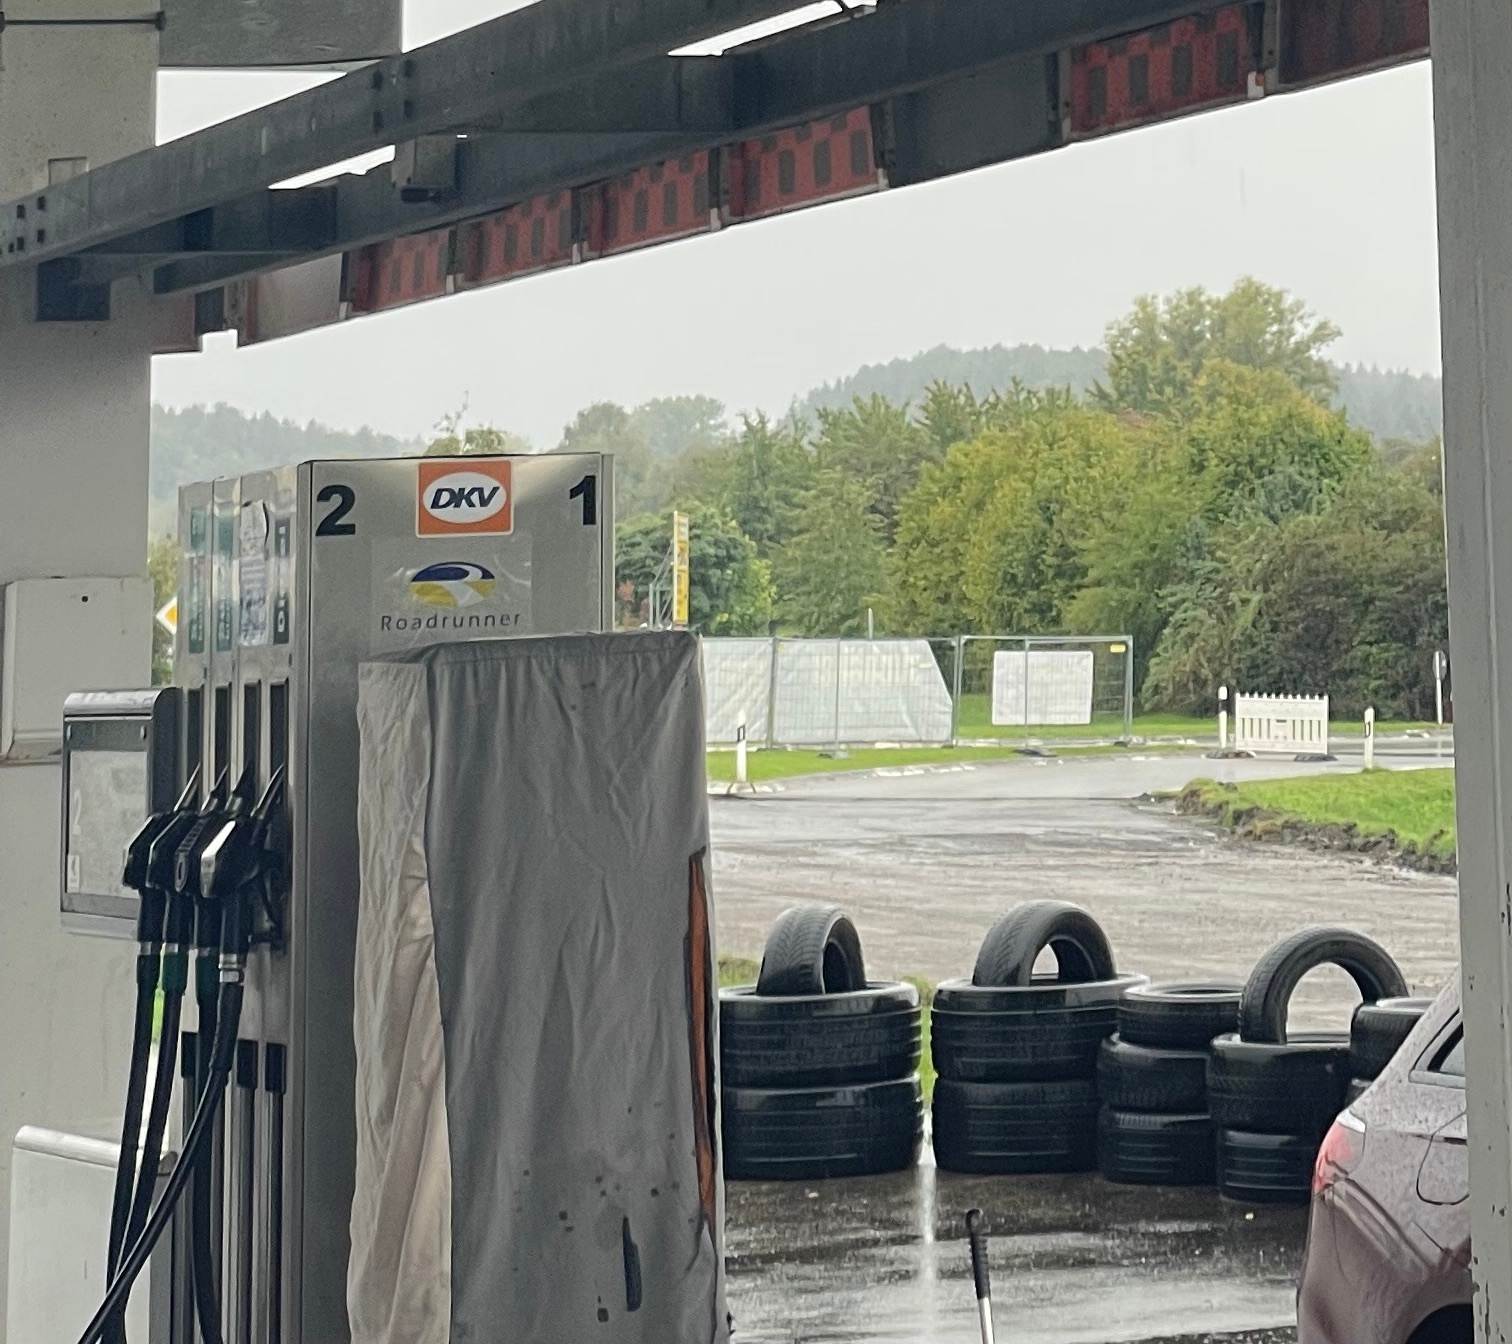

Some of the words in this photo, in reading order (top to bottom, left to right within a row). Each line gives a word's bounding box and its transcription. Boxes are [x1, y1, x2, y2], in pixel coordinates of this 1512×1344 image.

[315, 484, 356, 537] 2
[430, 486, 500, 510] DKV
[569, 475, 597, 526] 1
[381, 611, 521, 631] Roadrunner
